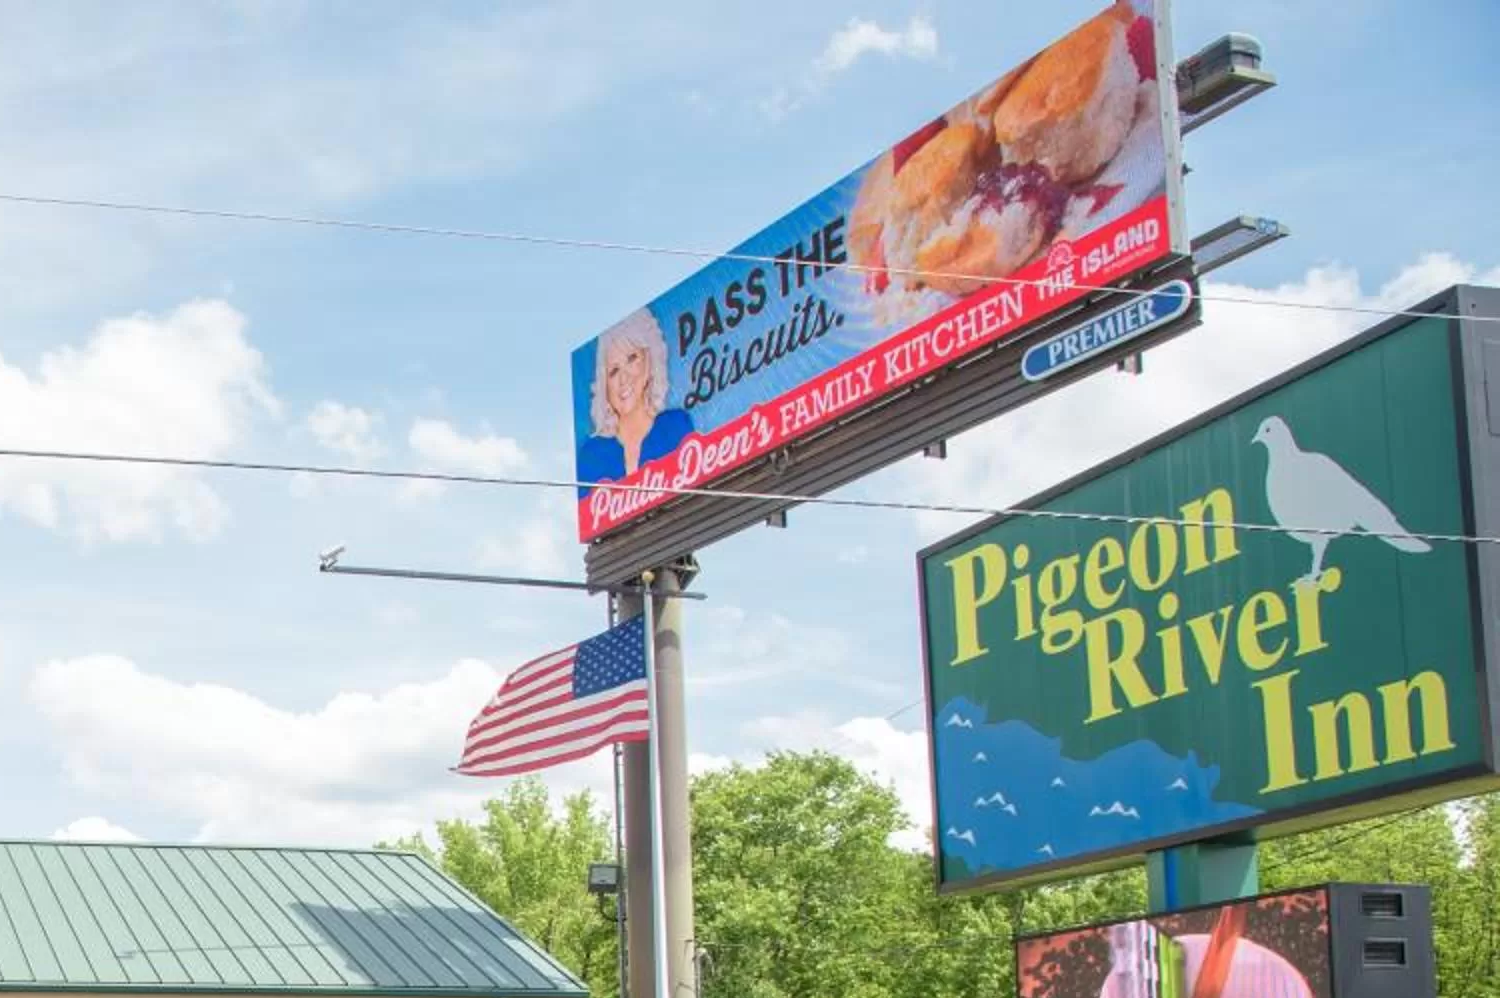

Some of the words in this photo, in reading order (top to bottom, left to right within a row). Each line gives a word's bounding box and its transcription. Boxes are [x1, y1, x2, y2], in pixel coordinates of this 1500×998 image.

[678, 267, 767, 357] PASS
[773, 216, 847, 297] THE
[1033, 265, 1077, 301] THE
[1081, 219, 1160, 278] ISLAND
[684, 295, 845, 409] Biscuits.
[1048, 299, 1157, 367] PREMIER
[590, 468, 670, 530] Paula
[673, 411, 775, 491] Deen's
[779, 359, 877, 437] FAMILY
[884, 283, 1026, 385] KITCHEN
[944, 488, 1241, 667] Pigeon
[1083, 566, 1343, 725] River
[1251, 668, 1457, 795] Inn
